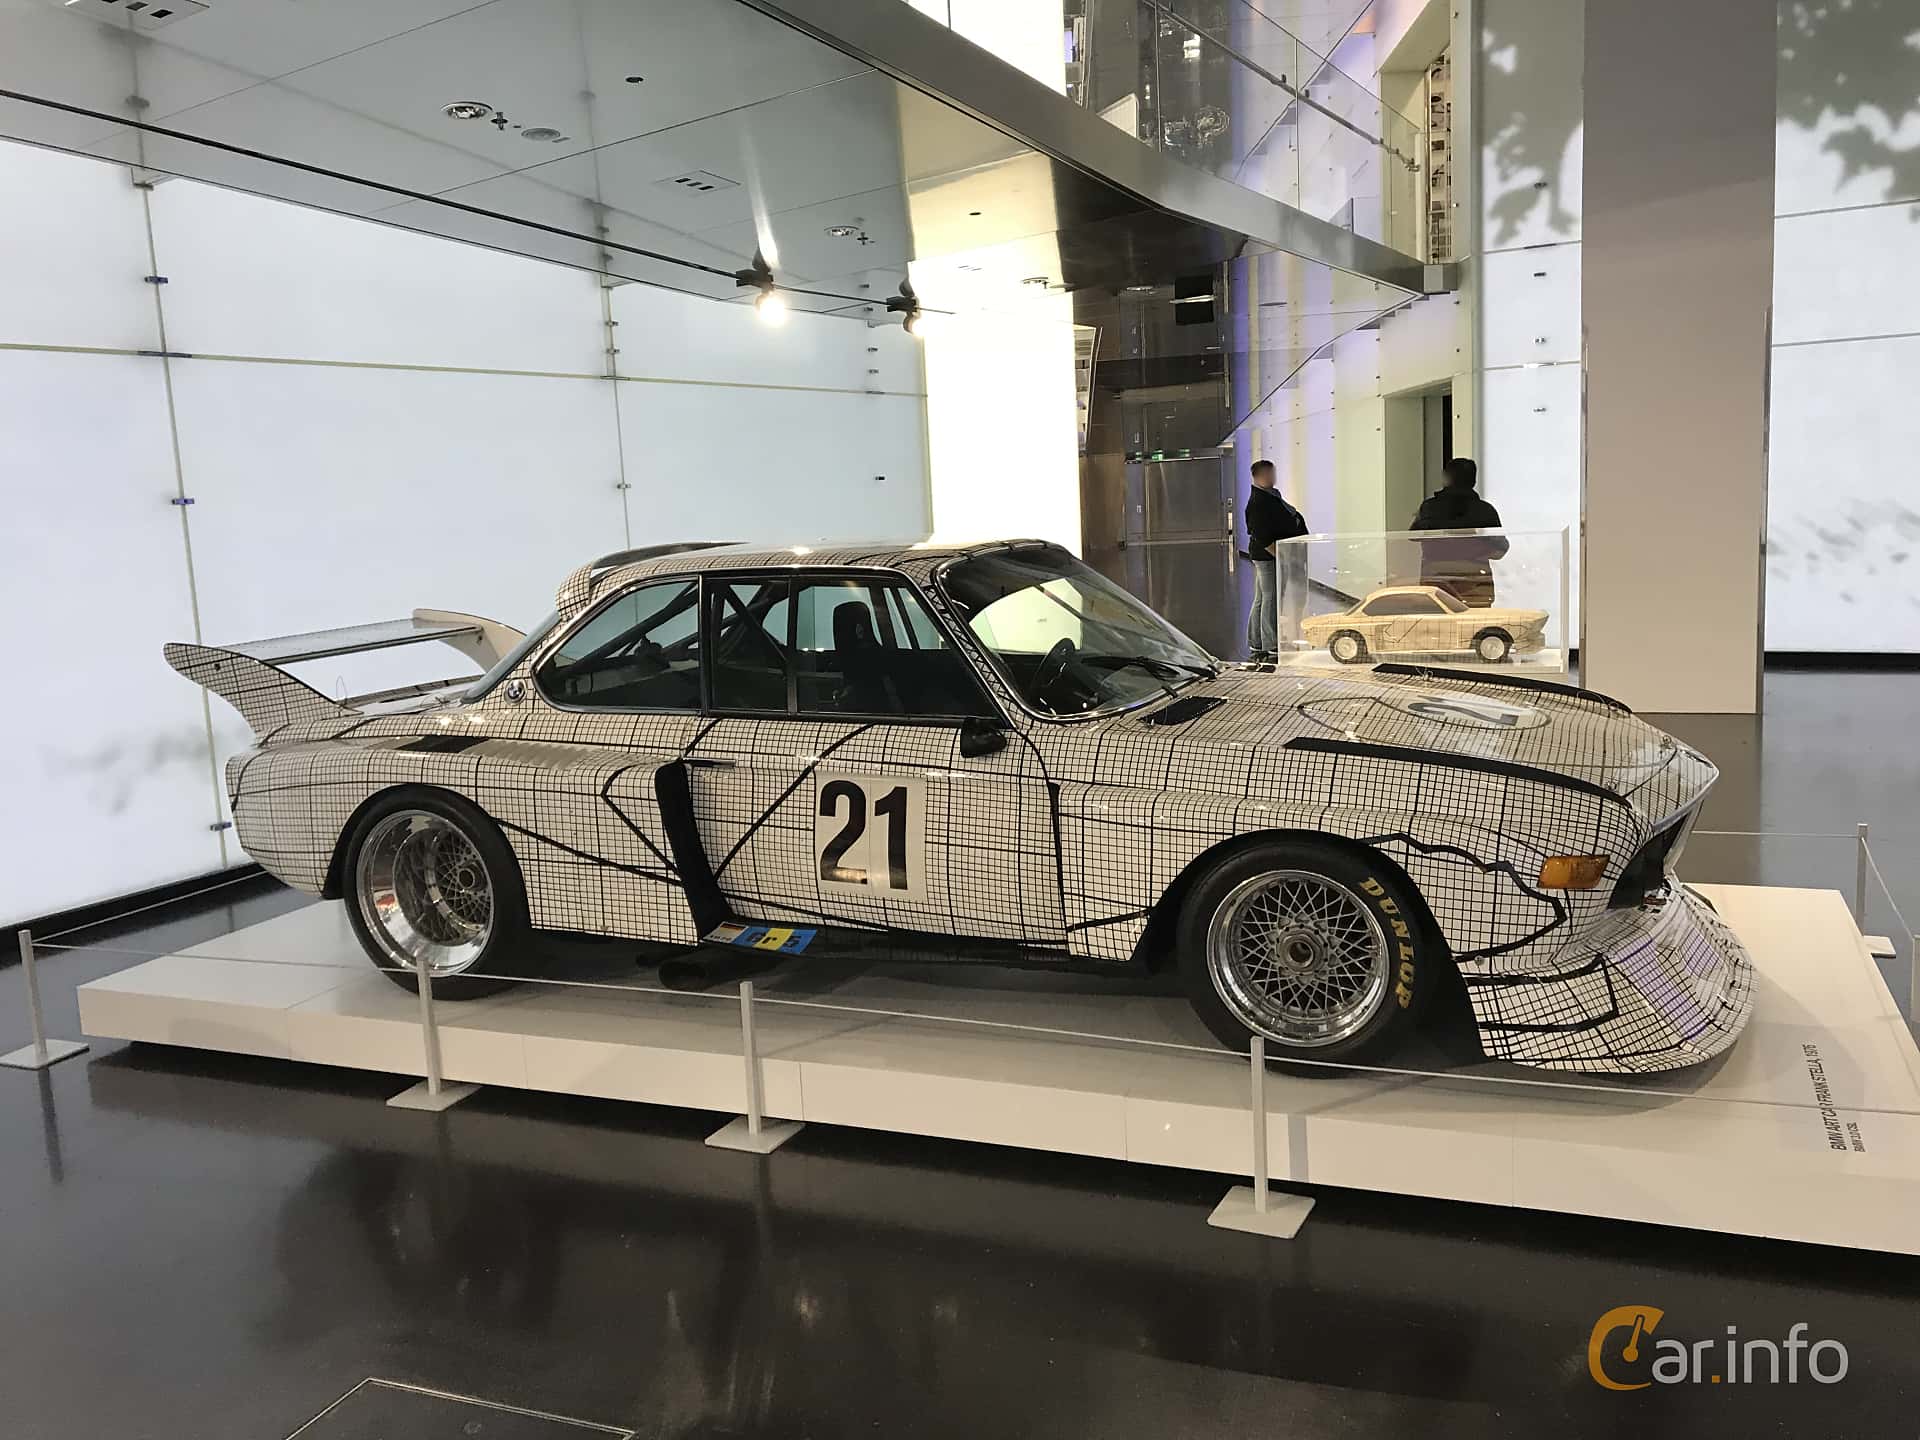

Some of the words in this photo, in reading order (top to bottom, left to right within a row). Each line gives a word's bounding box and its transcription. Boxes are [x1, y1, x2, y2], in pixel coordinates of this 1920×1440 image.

[819, 779, 908, 891] 21
[1360, 876, 1416, 1009] DUNLOP
[1814, 1082, 1832, 1102] FRANK
[1823, 1116, 1841, 1131] ART
[1828, 1133, 1847, 1150] BMW
